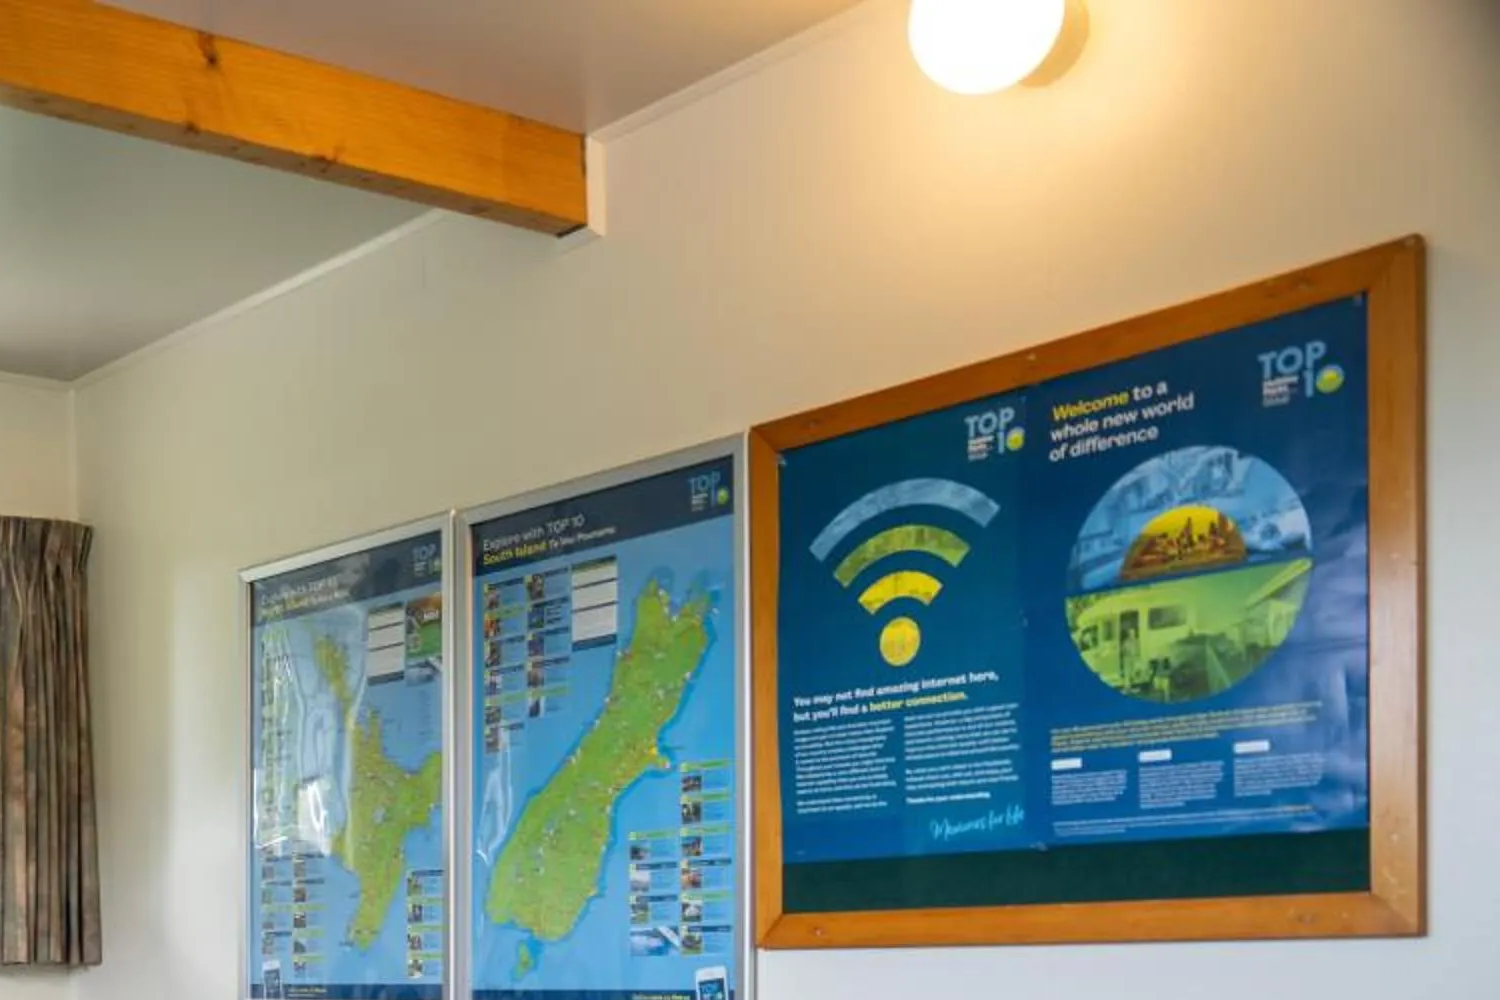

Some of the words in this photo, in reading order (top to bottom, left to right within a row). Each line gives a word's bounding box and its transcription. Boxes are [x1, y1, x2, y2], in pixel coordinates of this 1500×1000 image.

[1257, 341, 1326, 381] TOP
[1051, 417, 1099, 442] whole
[1103, 409, 1138, 429] new
[1142, 391, 1195, 419] world
[1053, 391, 1129, 422] Welcome
[1132, 385, 1153, 401] to
[1156, 380, 1168, 396] a
[964, 407, 1015, 437] TOP
[1048, 441, 1069, 462] of
[1070, 426, 1160, 457] difference
[688, 472, 721, 494] TOP
[522, 526, 545, 541] with
[546, 517, 570, 534] TOP
[483, 548, 513, 565] South
[515, 542, 548, 558] Island
[793, 697, 811, 707] You
[812, 695, 833, 705] may
[836, 690, 853, 701] not
[854, 687, 875, 698] find
[876, 682, 919, 695] amazing
[921, 674, 966, 689] internet
[793, 711, 810, 722] but
[840, 703, 859, 715] find
[869, 699, 903, 712] better
